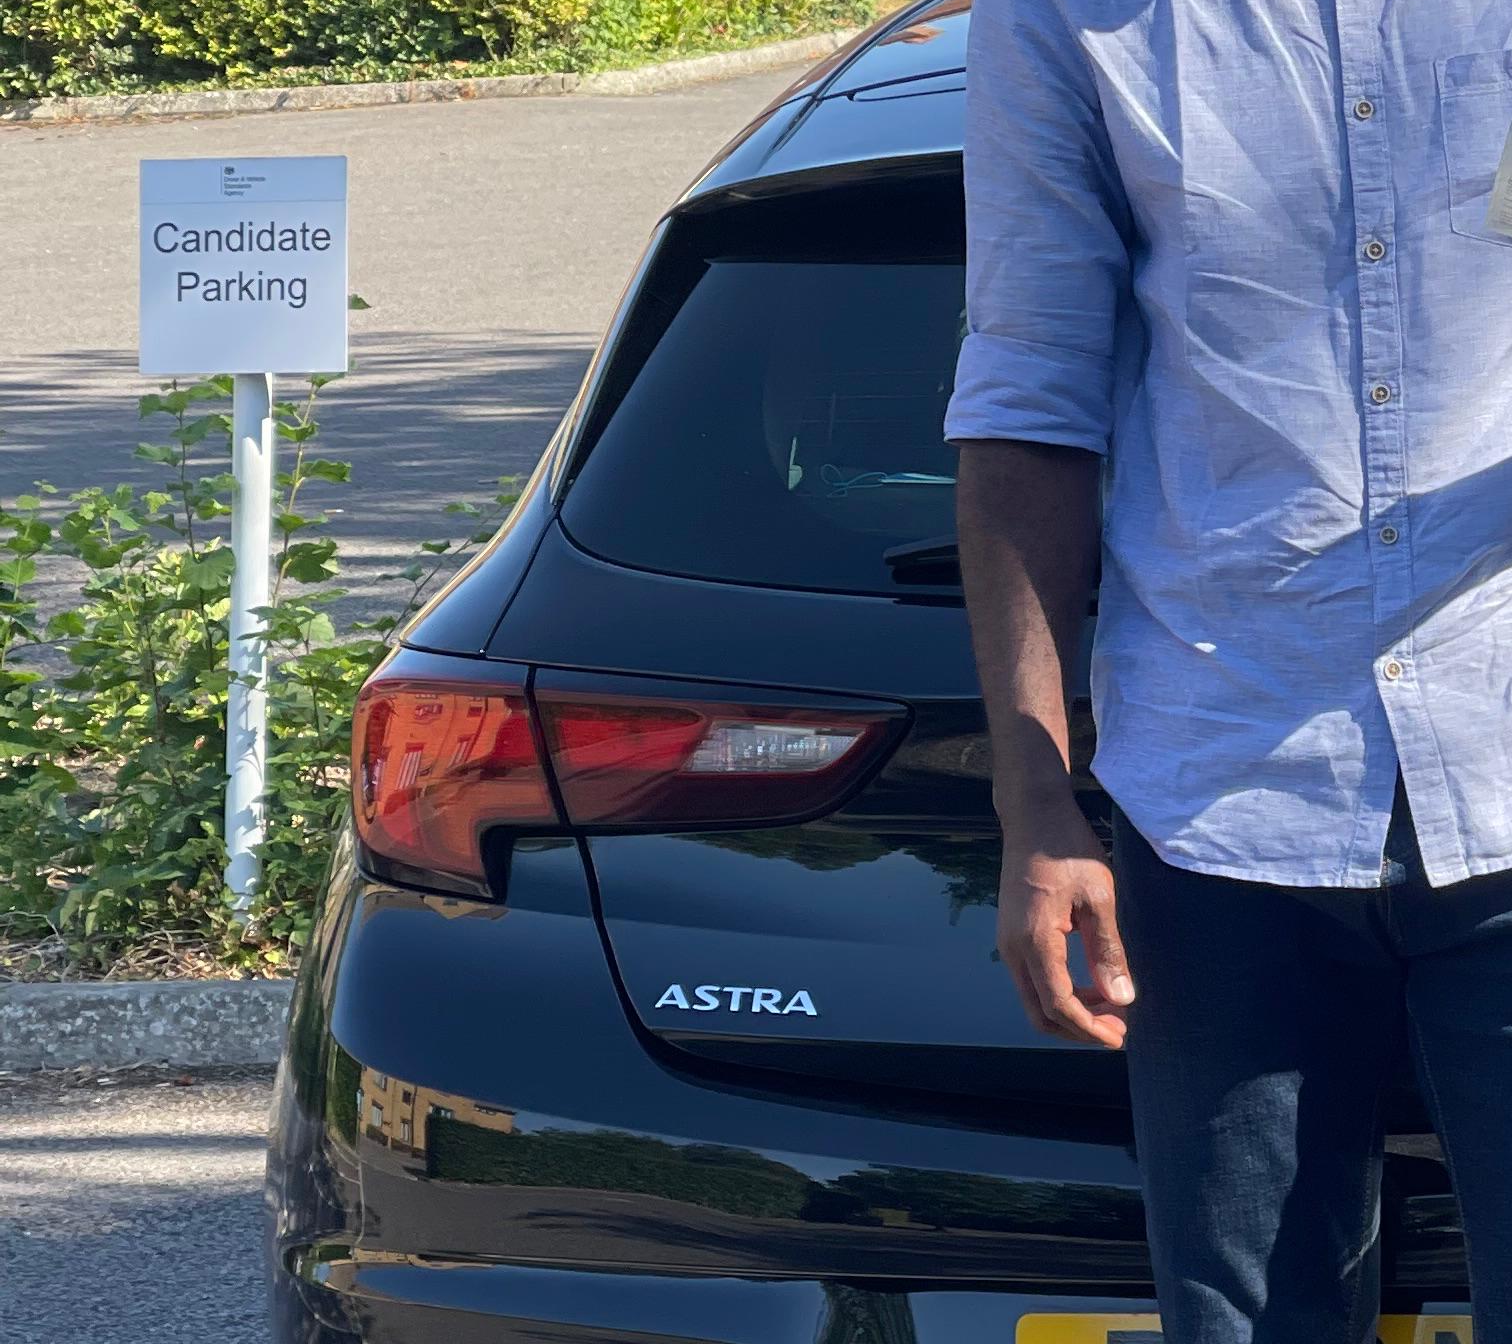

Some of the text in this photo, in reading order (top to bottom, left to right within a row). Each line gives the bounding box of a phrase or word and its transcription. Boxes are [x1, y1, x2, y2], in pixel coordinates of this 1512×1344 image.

[153, 221, 331, 254] Candidate
[177, 270, 307, 309] Parking
[654, 983, 818, 1016] ASTRA
